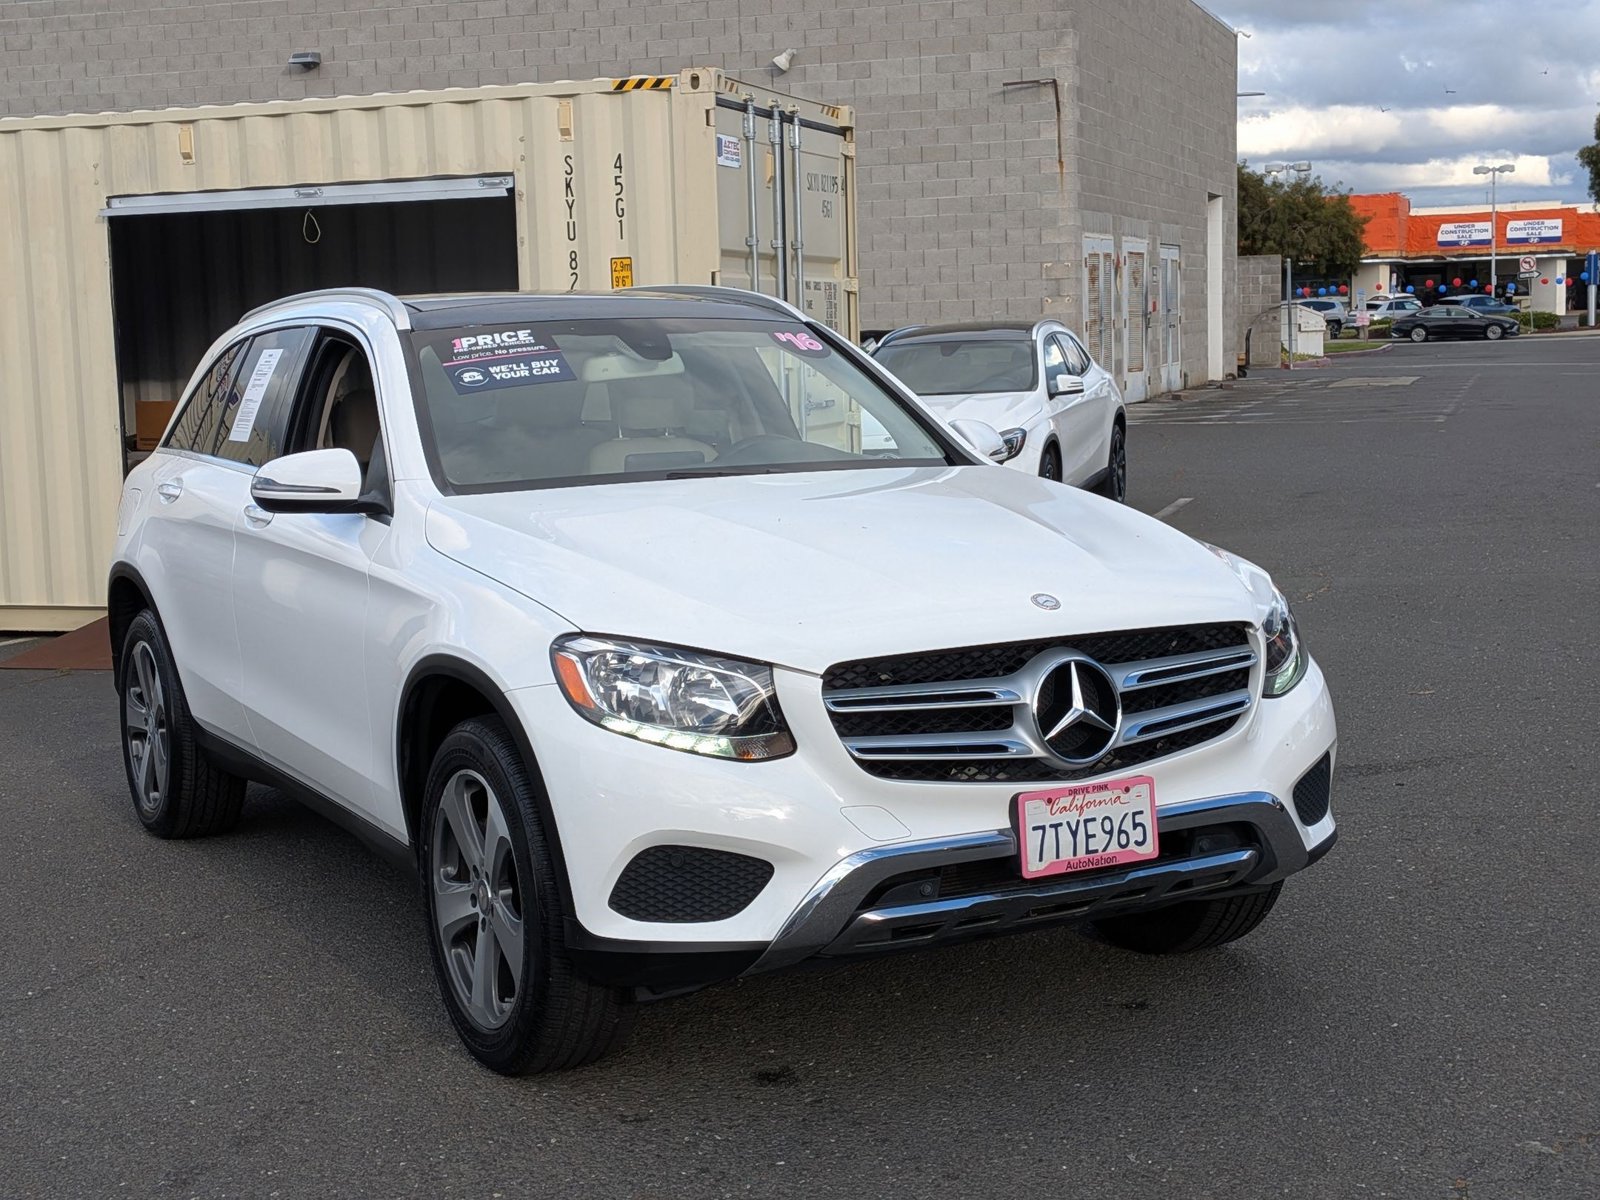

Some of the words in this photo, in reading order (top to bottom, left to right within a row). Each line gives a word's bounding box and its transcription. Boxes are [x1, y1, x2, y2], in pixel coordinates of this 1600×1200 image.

[564, 155, 576, 241] SKYU
[613, 153, 625, 240] 45G1
[453, 343, 498, 353] PRE-OWNED
[471, 351, 493, 359] price.
[508, 345, 548, 354] pressure.
[488, 364, 529, 374] WE'LL
[531, 359, 559, 368] BUY
[492, 371, 530, 380] YOUR
[532, 367, 561, 376] CAR
[1068, 786, 1091, 796] DRIVE
[1091, 783, 1110, 793] PINK
[1050, 792, 1130, 818] California
[1031, 810, 1147, 863] 7TYE965
